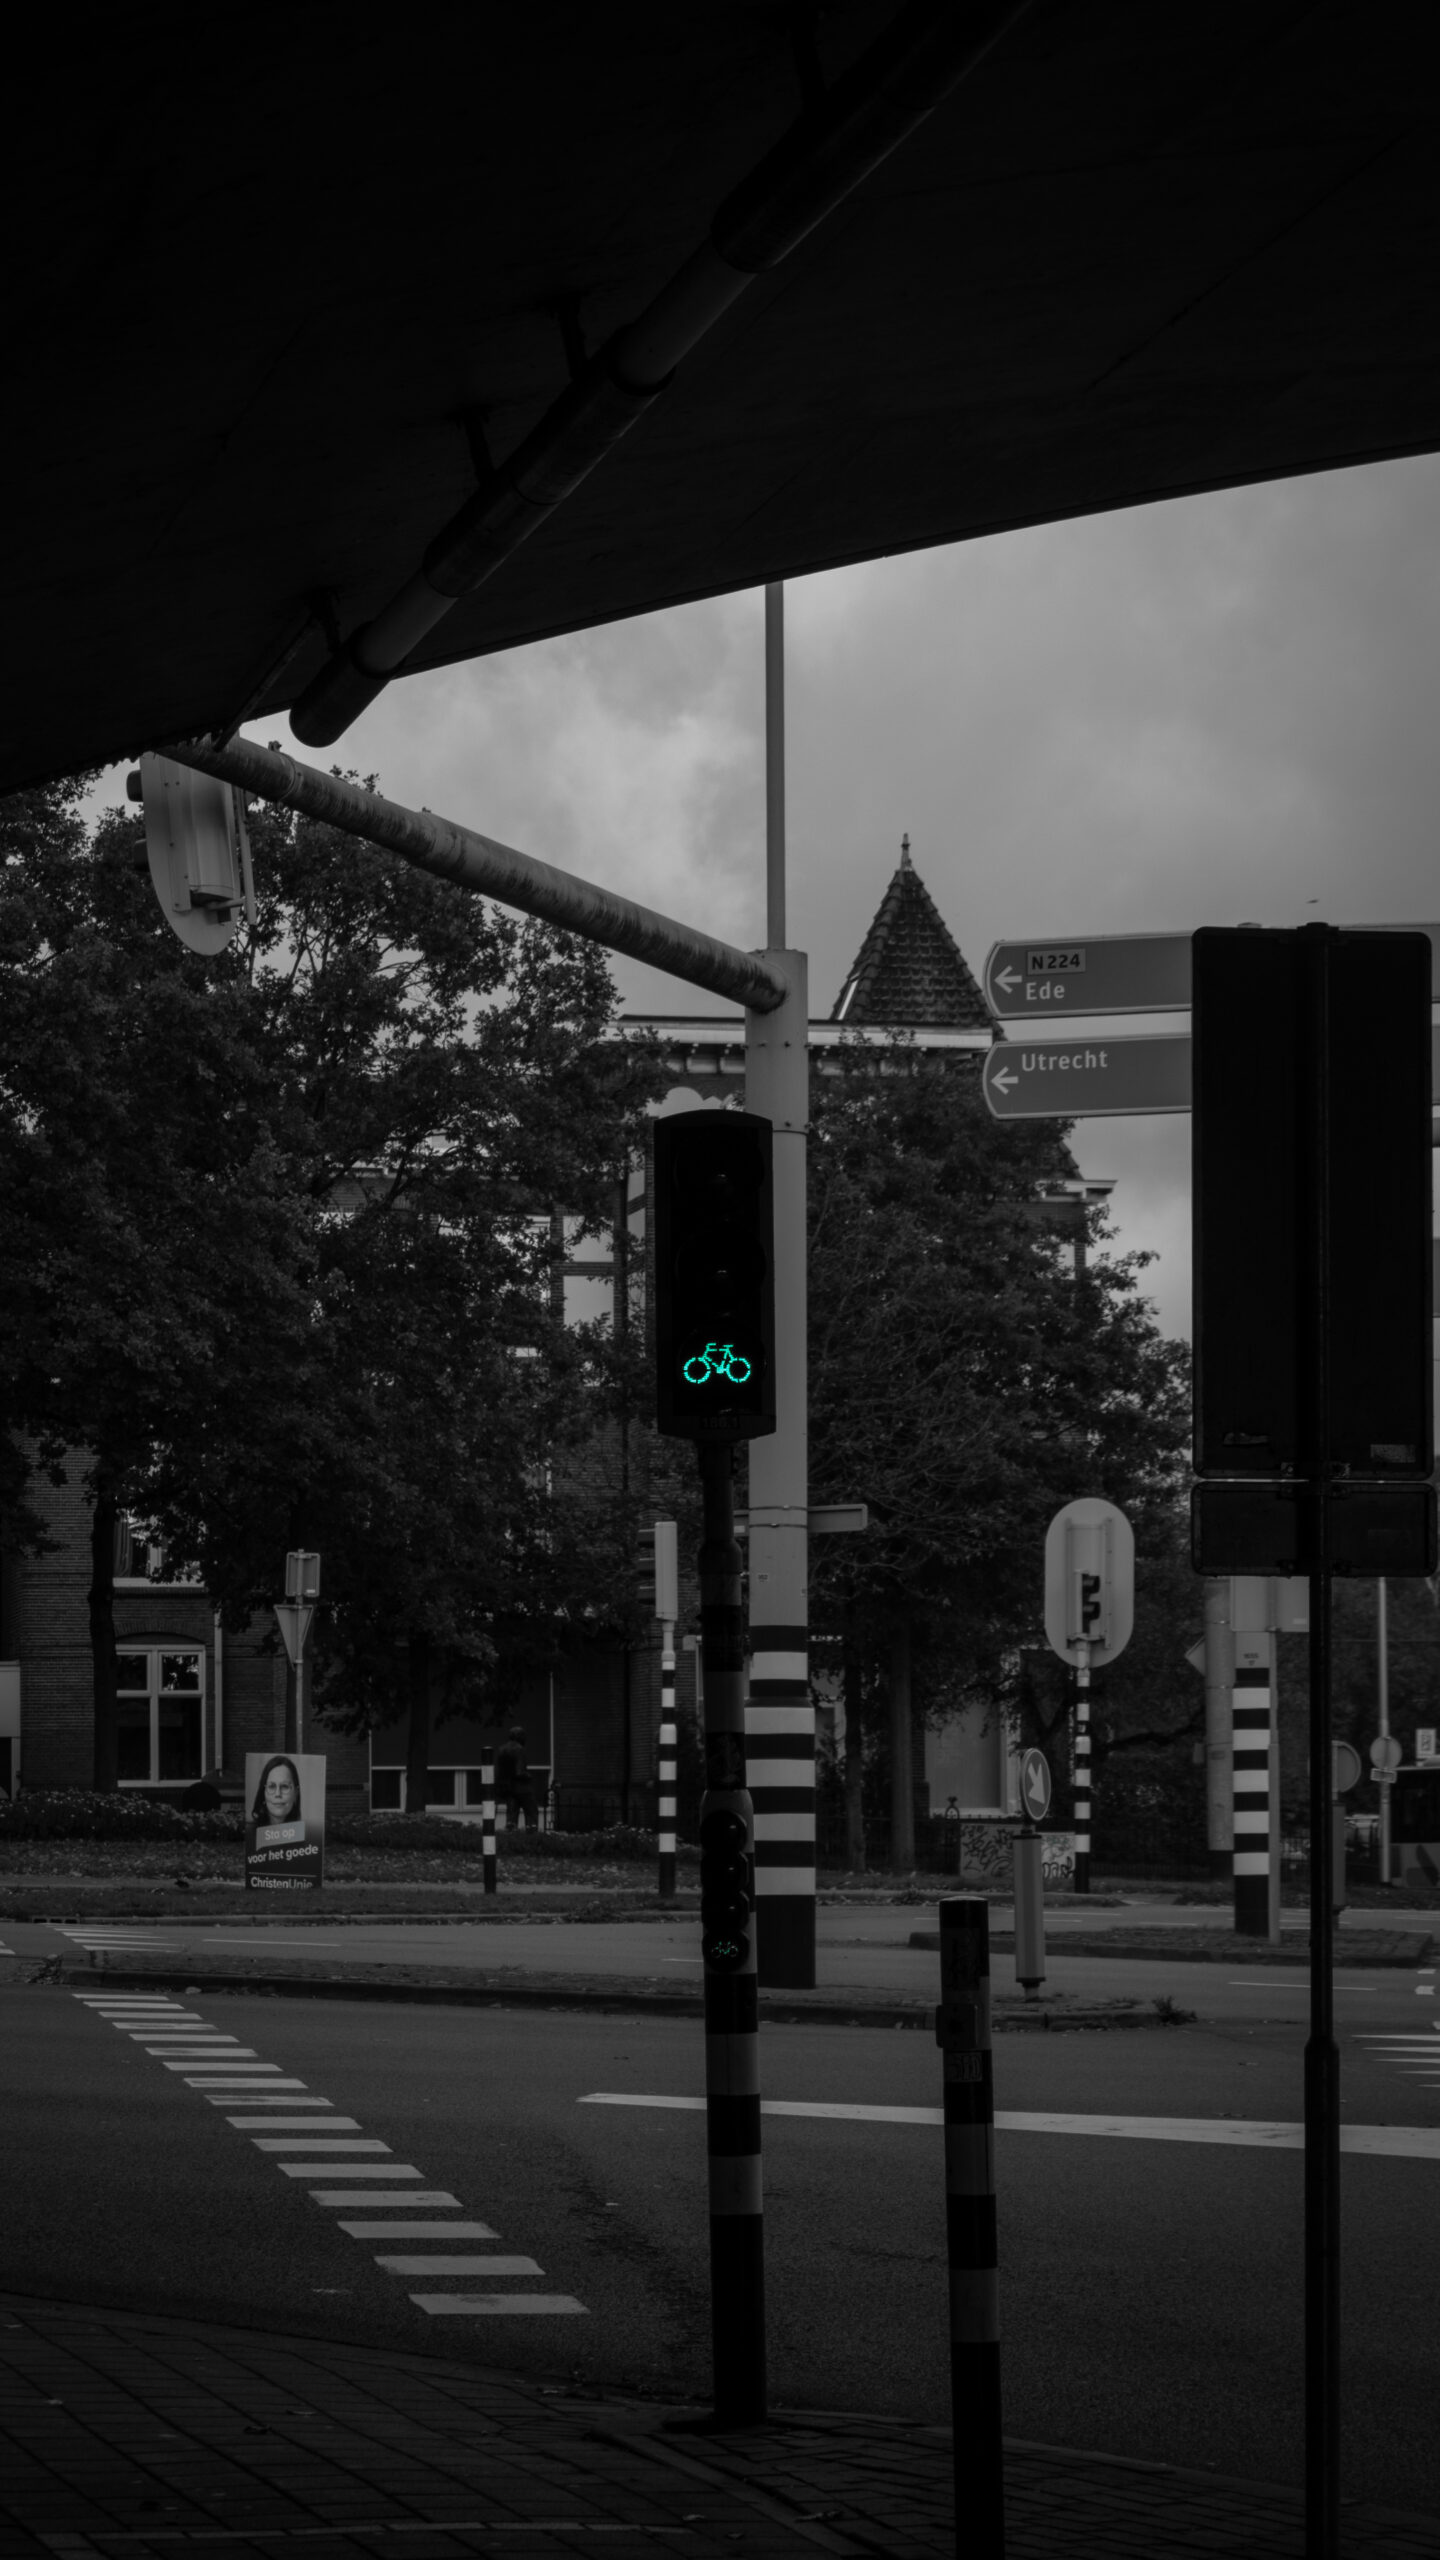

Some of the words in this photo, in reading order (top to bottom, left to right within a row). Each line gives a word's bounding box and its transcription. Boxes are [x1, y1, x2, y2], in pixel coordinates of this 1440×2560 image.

[1025, 981, 1066, 1001] Ede
[1021, 1049, 1109, 1073] Utrecht
[281, 1828, 296, 1839] op
[247, 1853, 268, 1865] voor
[268, 1849, 284, 1861] het
[285, 1844, 319, 1861] goede
